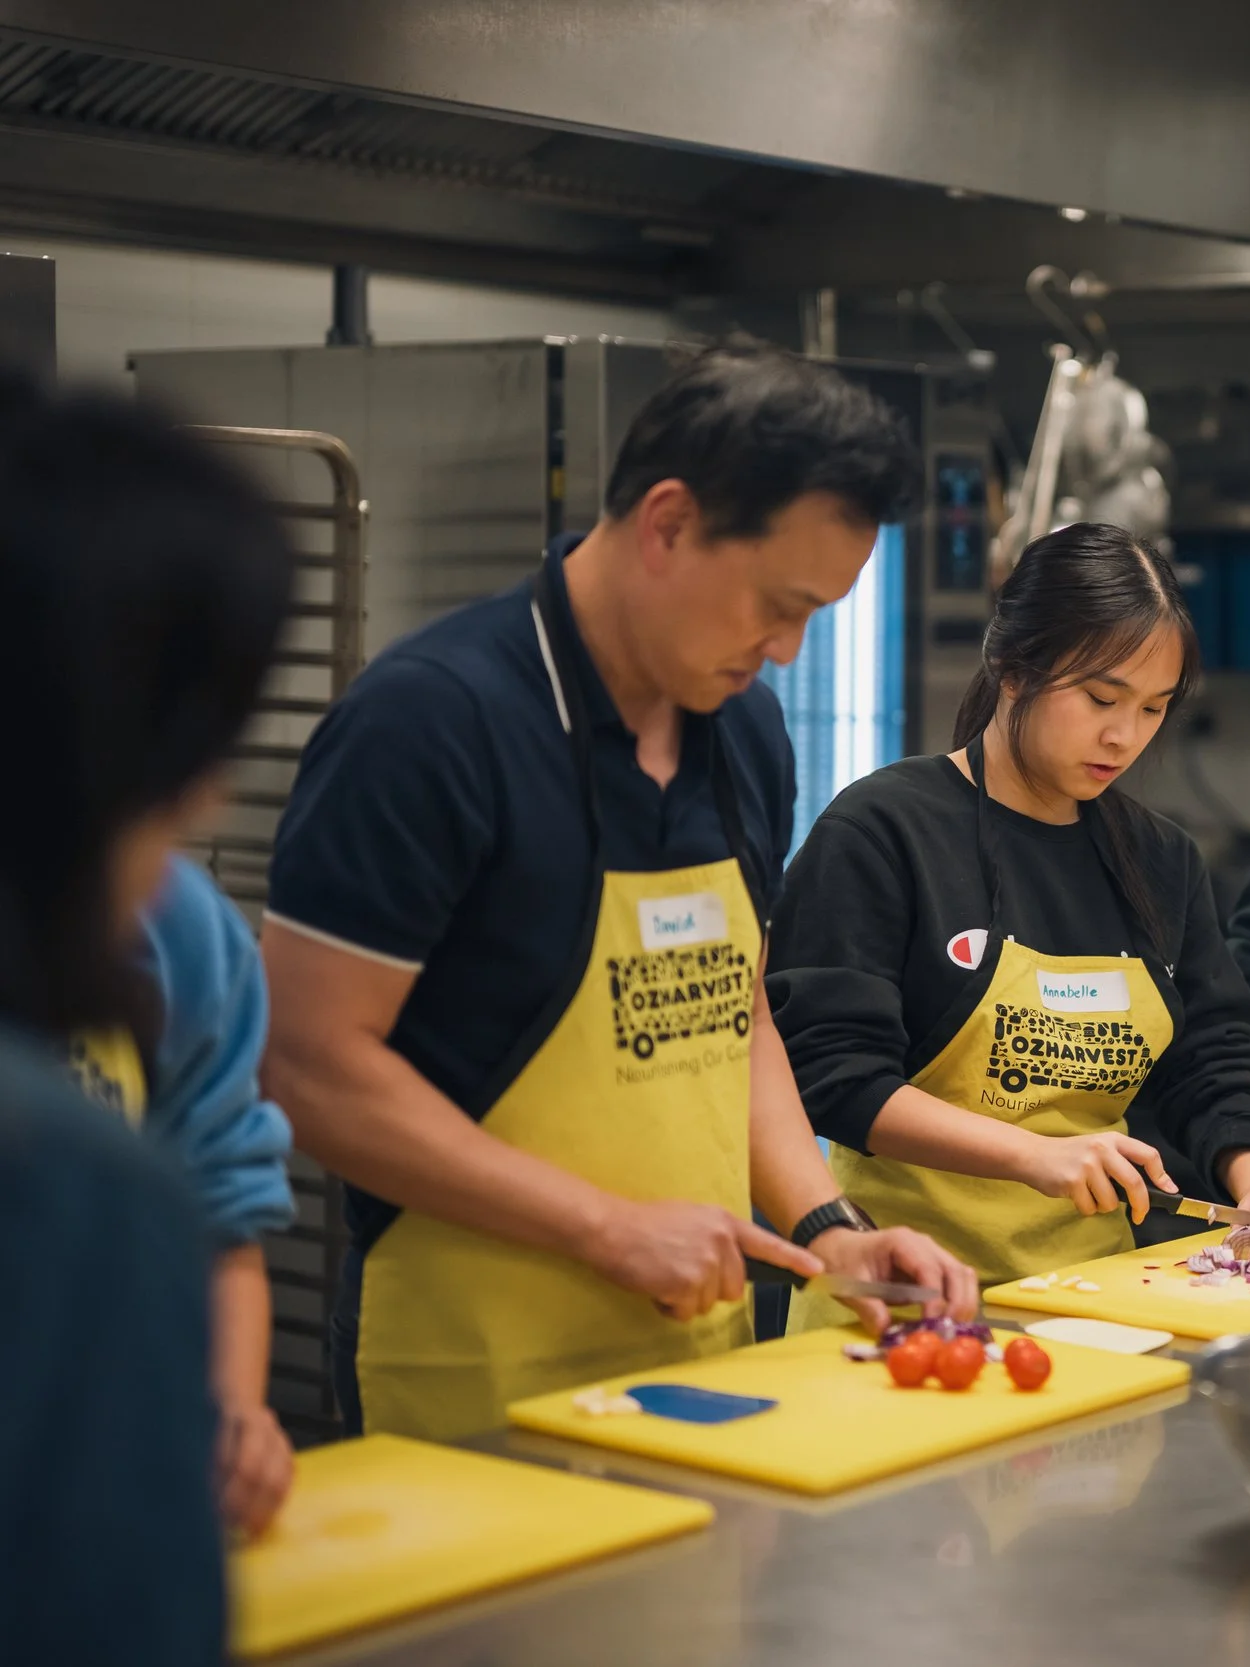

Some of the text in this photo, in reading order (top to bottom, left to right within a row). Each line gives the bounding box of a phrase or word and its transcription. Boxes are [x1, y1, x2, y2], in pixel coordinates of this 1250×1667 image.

[652, 912, 696, 936] David
[1043, 984, 1098, 999] Annabelle
[1011, 1035, 1138, 1066] OZHARVEST
